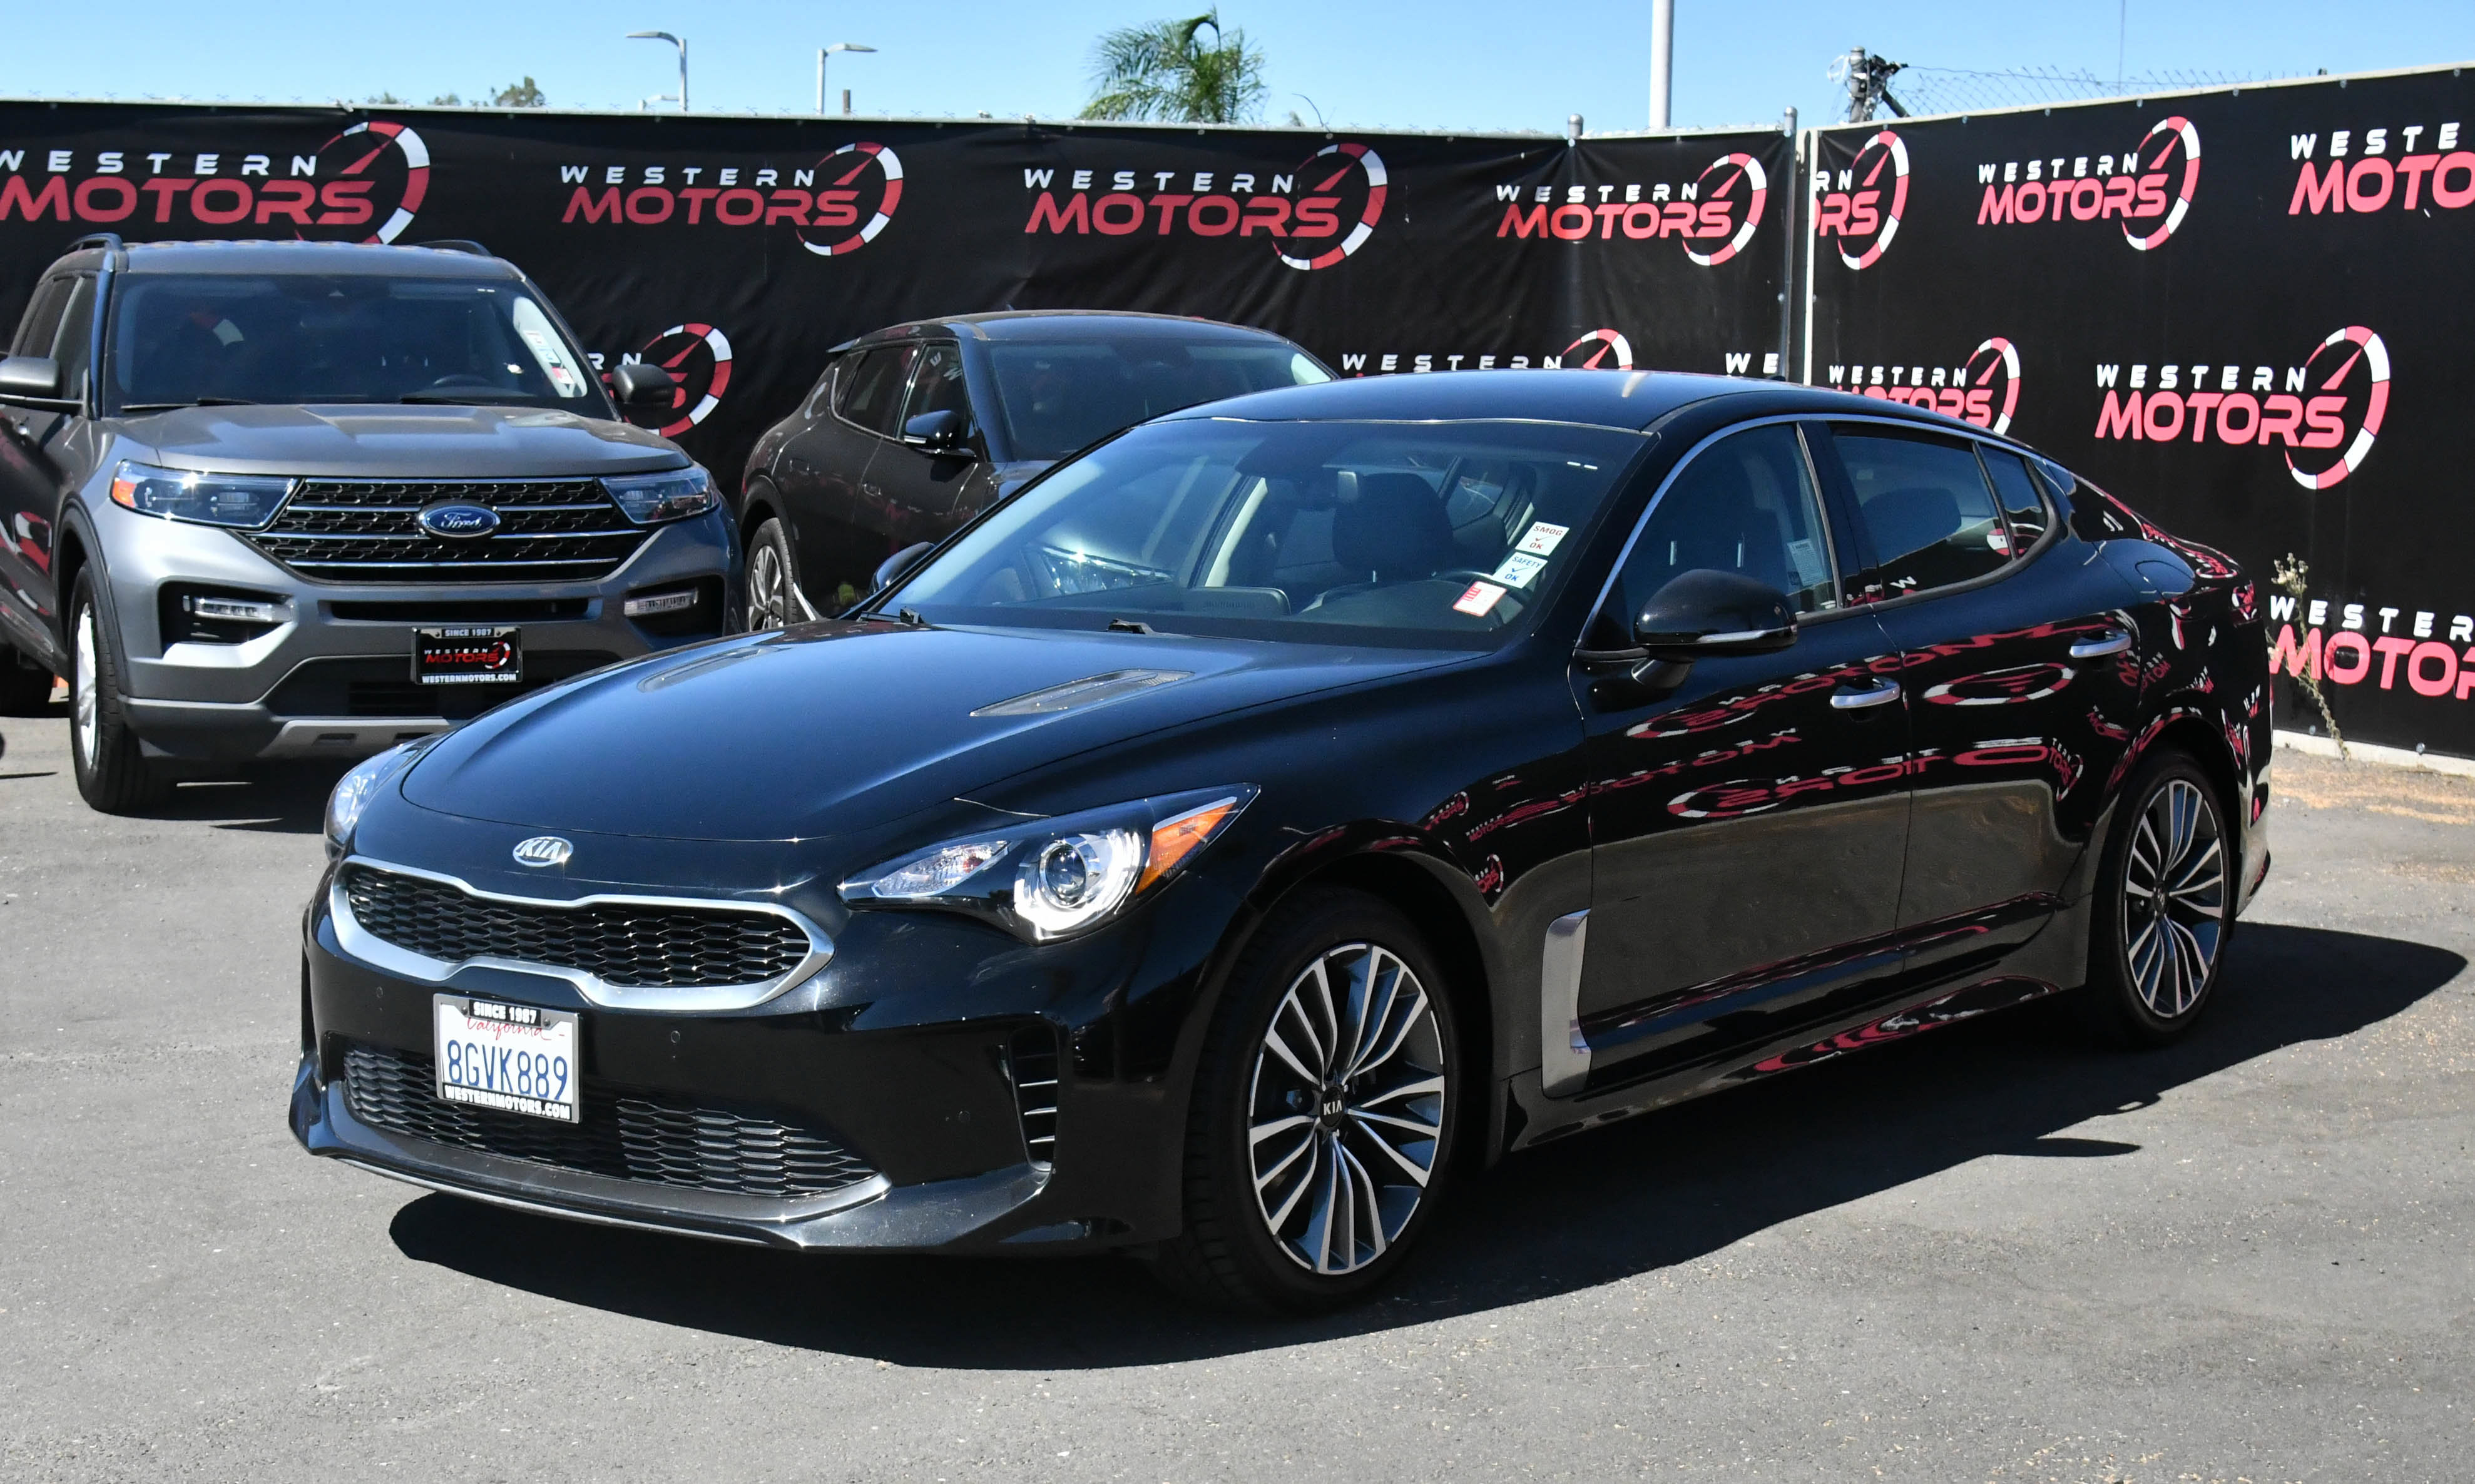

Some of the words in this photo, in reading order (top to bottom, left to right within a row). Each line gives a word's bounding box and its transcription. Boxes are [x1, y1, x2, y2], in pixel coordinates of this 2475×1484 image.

[0, 150, 317, 176] WESTERN
[1978, 153, 2138, 183] WESTERN
[561, 166, 814, 186] WESTERN
[1024, 168, 1294, 193] WESTERN
[0, 175, 375, 225] MOTORS
[1496, 183, 1698, 202] WESTERN
[1977, 173, 2169, 225] MOTORS
[562, 186, 860, 226] MOTORS
[1024, 192, 1342, 238] MOTORS
[1815, 190, 1880, 236] RS
[1497, 203, 1733, 240] MOTORS
[1342, 354, 1563, 372] WESTERN
[1829, 365, 1966, 387] WESTERN
[2096, 364, 2306, 392] WESTERN
[2095, 390, 2347, 449] MOTORS
[441, 512, 482, 529] Ford
[1533, 526, 1563, 536] SMOG
[1512, 556, 1542, 568] SAFETY
[1504, 573, 1519, 581] OK
[445, 629, 469, 637] SINCE
[426, 653, 500, 664] MOTORS
[422, 673, 517, 683] WESTERNMOTORS.COM
[515, 840, 562, 860] KIA
[473, 1001, 506, 1020] SINCE
[509, 1007, 537, 1024] 1987
[447, 1039, 568, 1100] 8GVK889
[444, 1085, 570, 1120] WESTERNMOTORS.COM
[1323, 1099, 1342, 1116] KIA
